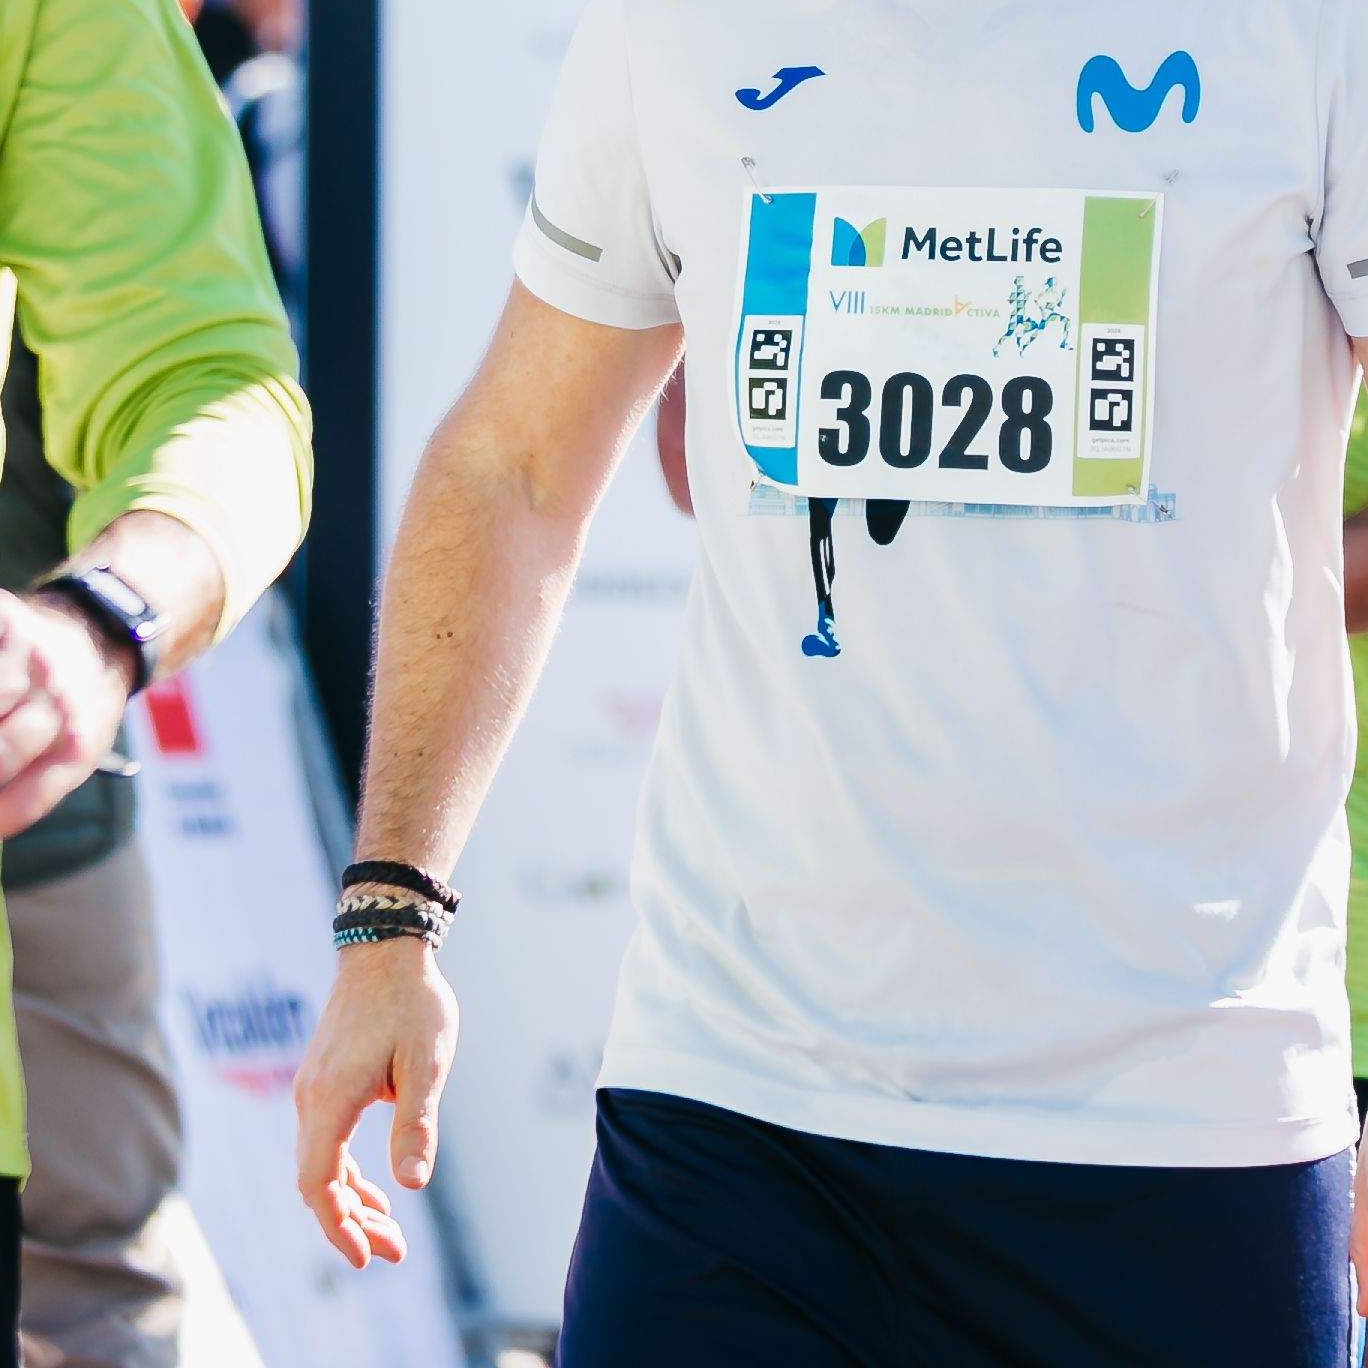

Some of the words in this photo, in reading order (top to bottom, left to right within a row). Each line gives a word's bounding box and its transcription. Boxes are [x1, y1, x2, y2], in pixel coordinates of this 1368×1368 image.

[901, 226, 1063, 264] MetLife
[828, 290, 866, 314] VIII
[817, 369, 1054, 474] 3028
